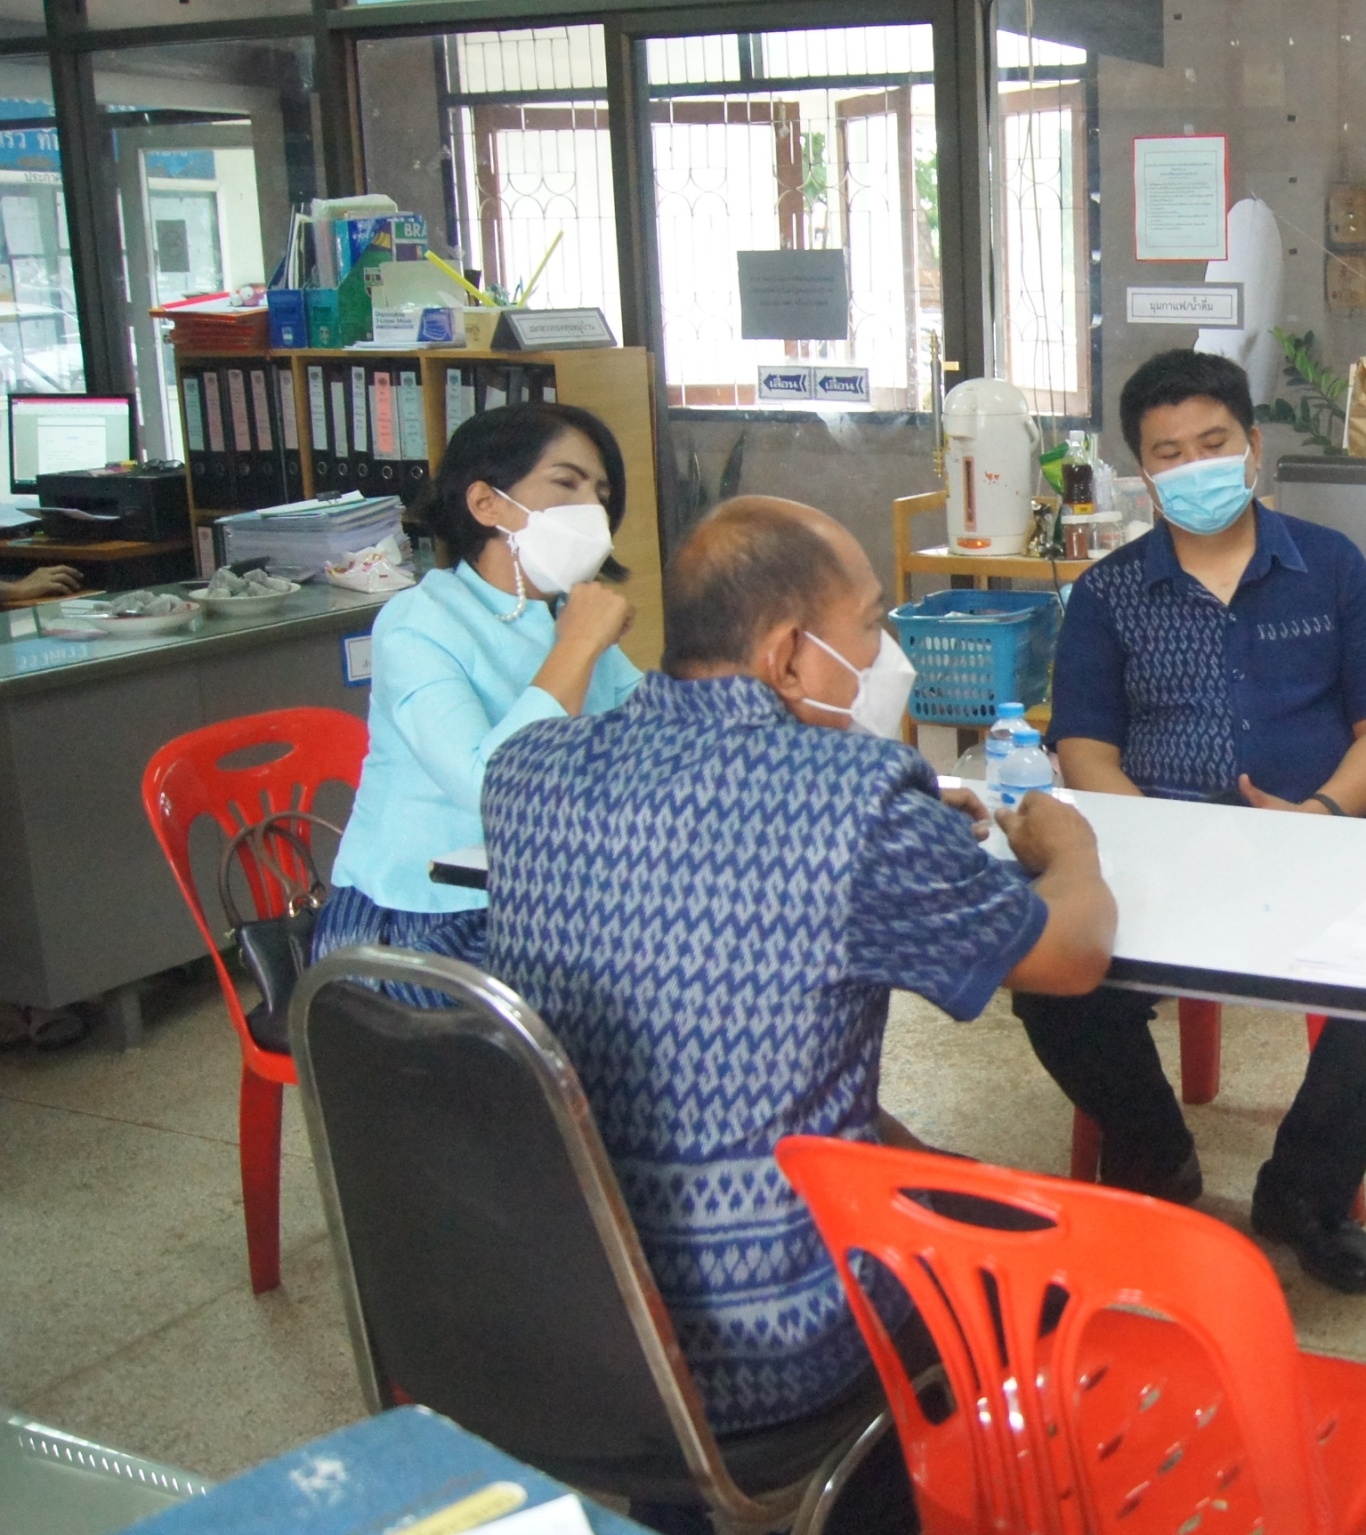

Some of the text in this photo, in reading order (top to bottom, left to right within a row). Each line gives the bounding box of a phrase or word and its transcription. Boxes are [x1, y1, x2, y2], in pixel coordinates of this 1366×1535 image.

[1150, 297, 1214, 314] มุมกาแฟ/น้ำดื่ม
